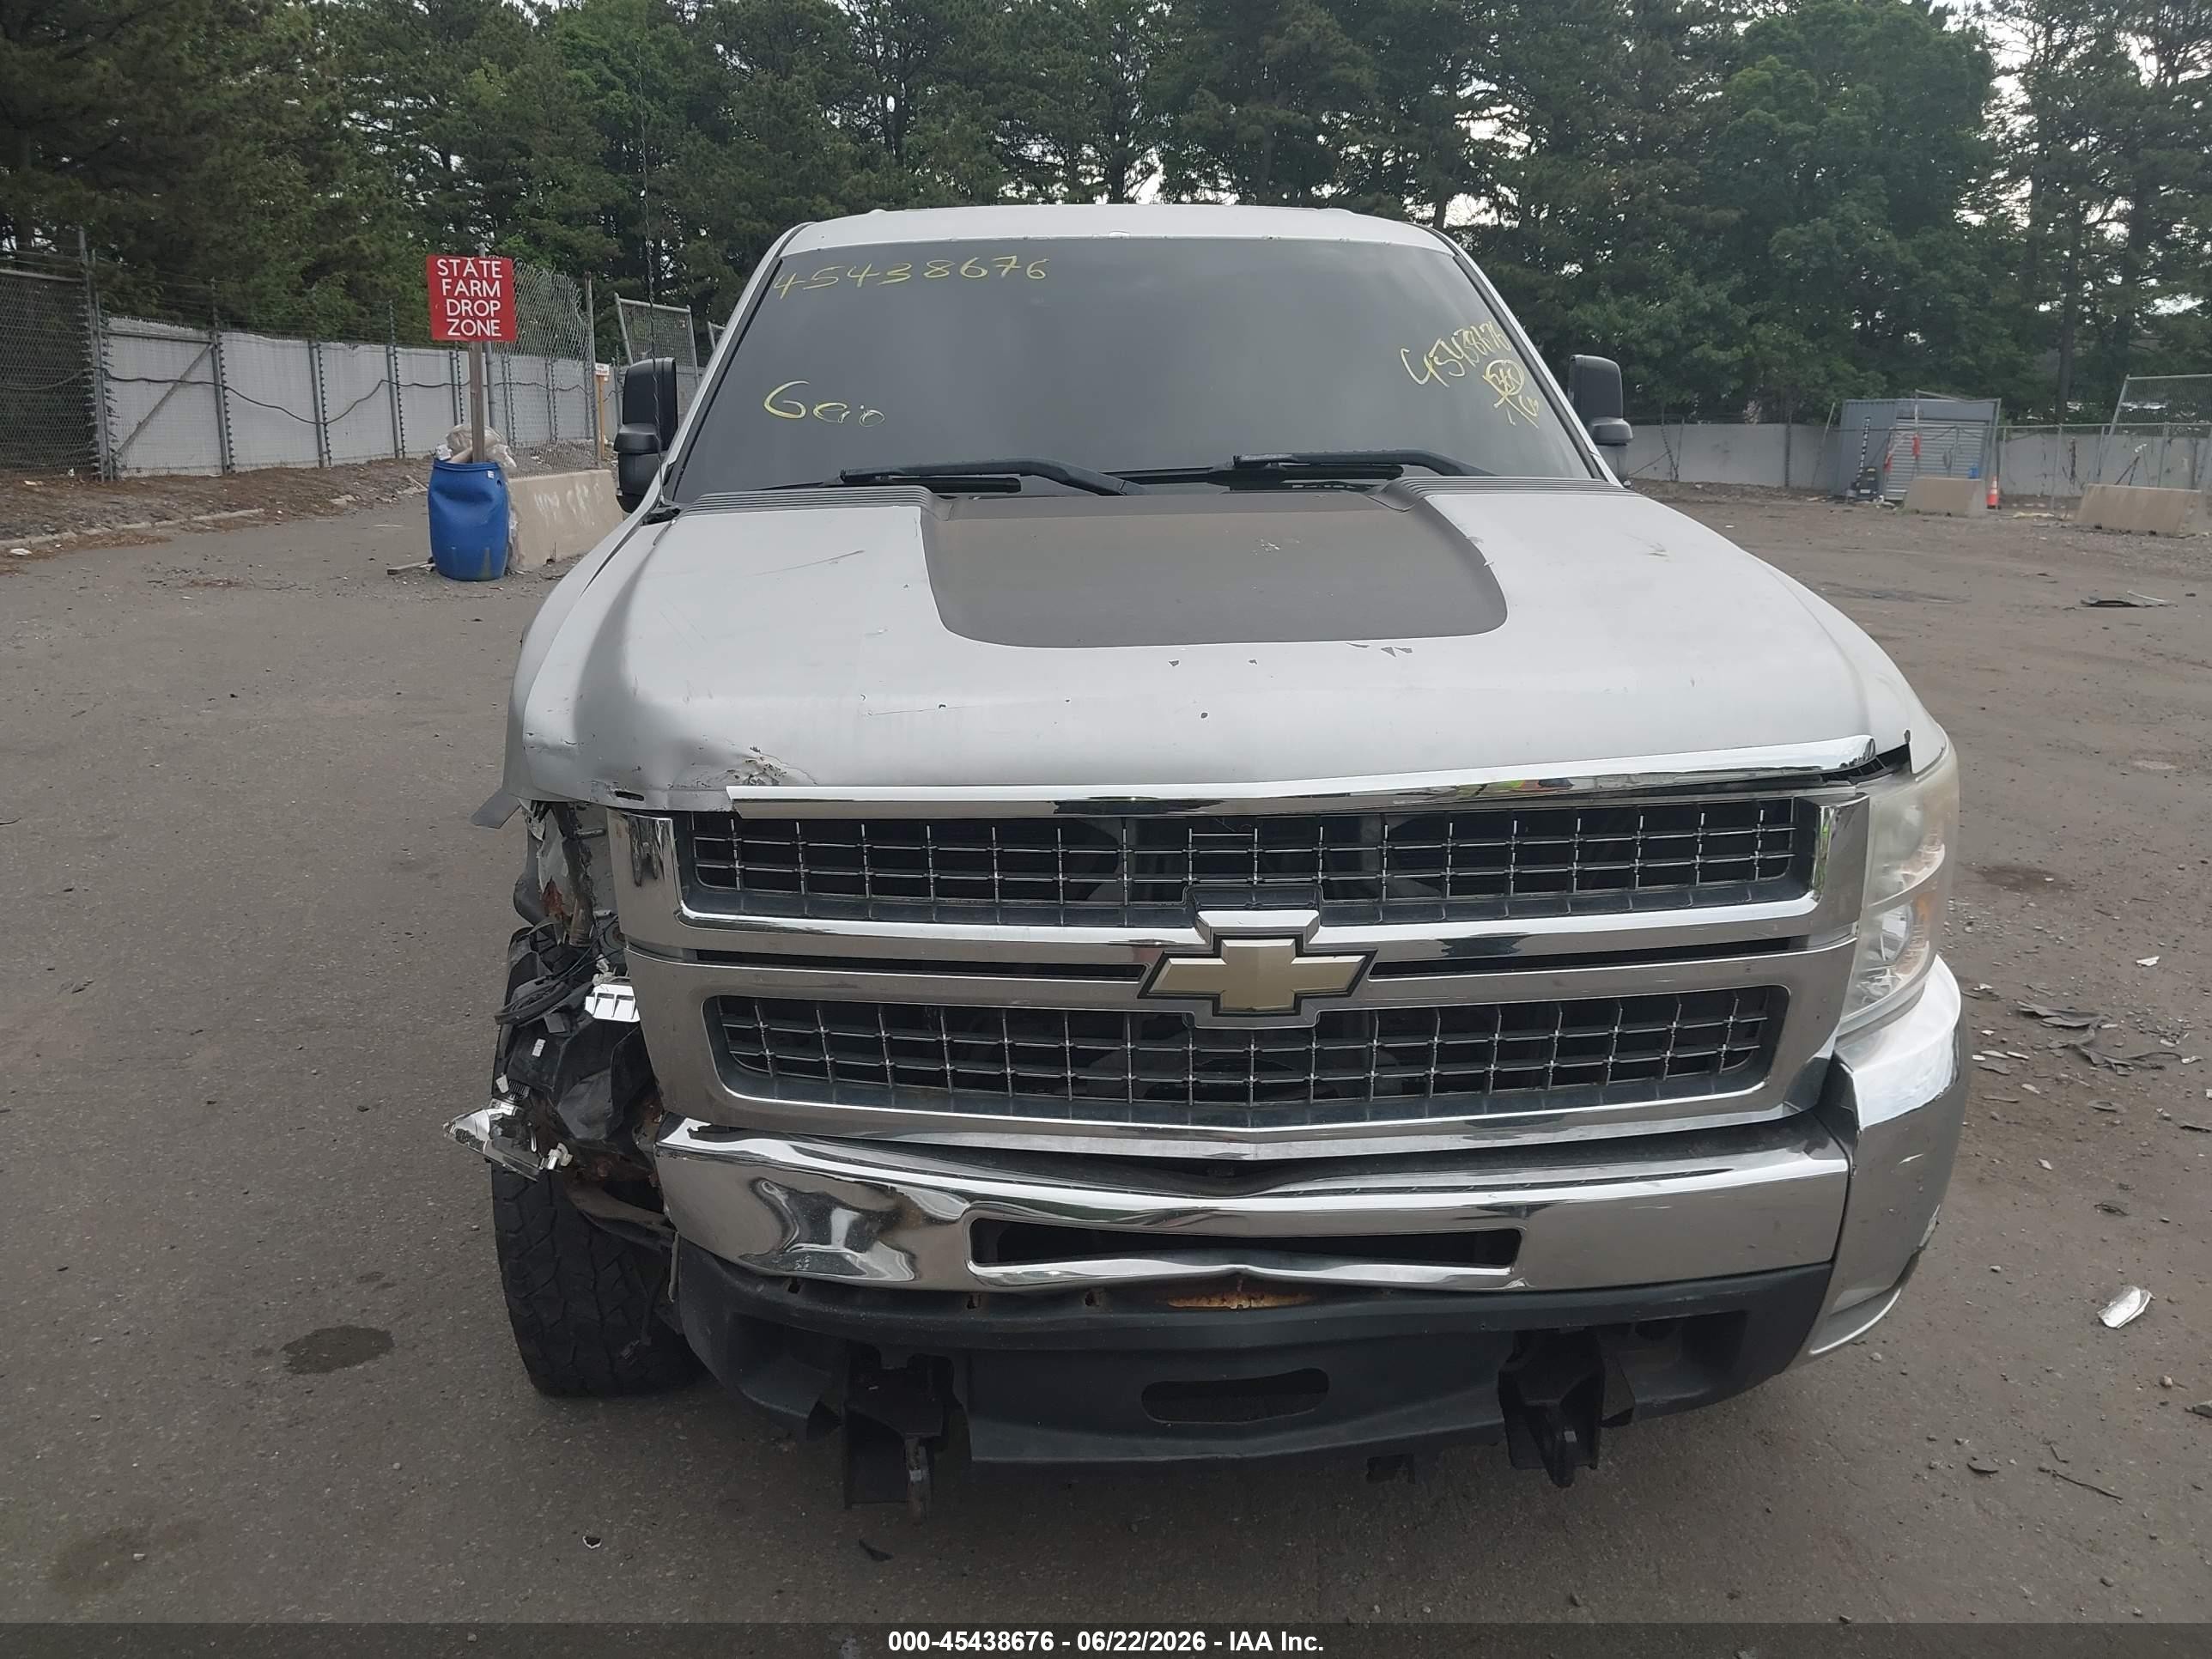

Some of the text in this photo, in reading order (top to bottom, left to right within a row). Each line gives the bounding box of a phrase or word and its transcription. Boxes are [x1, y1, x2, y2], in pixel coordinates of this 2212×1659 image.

[436, 258, 503, 278] STATE
[773, 255, 1051, 300] 45438676
[441, 278, 501, 298] FARM
[446, 298, 501, 318] DROP
[446, 318, 502, 337] ZONE
